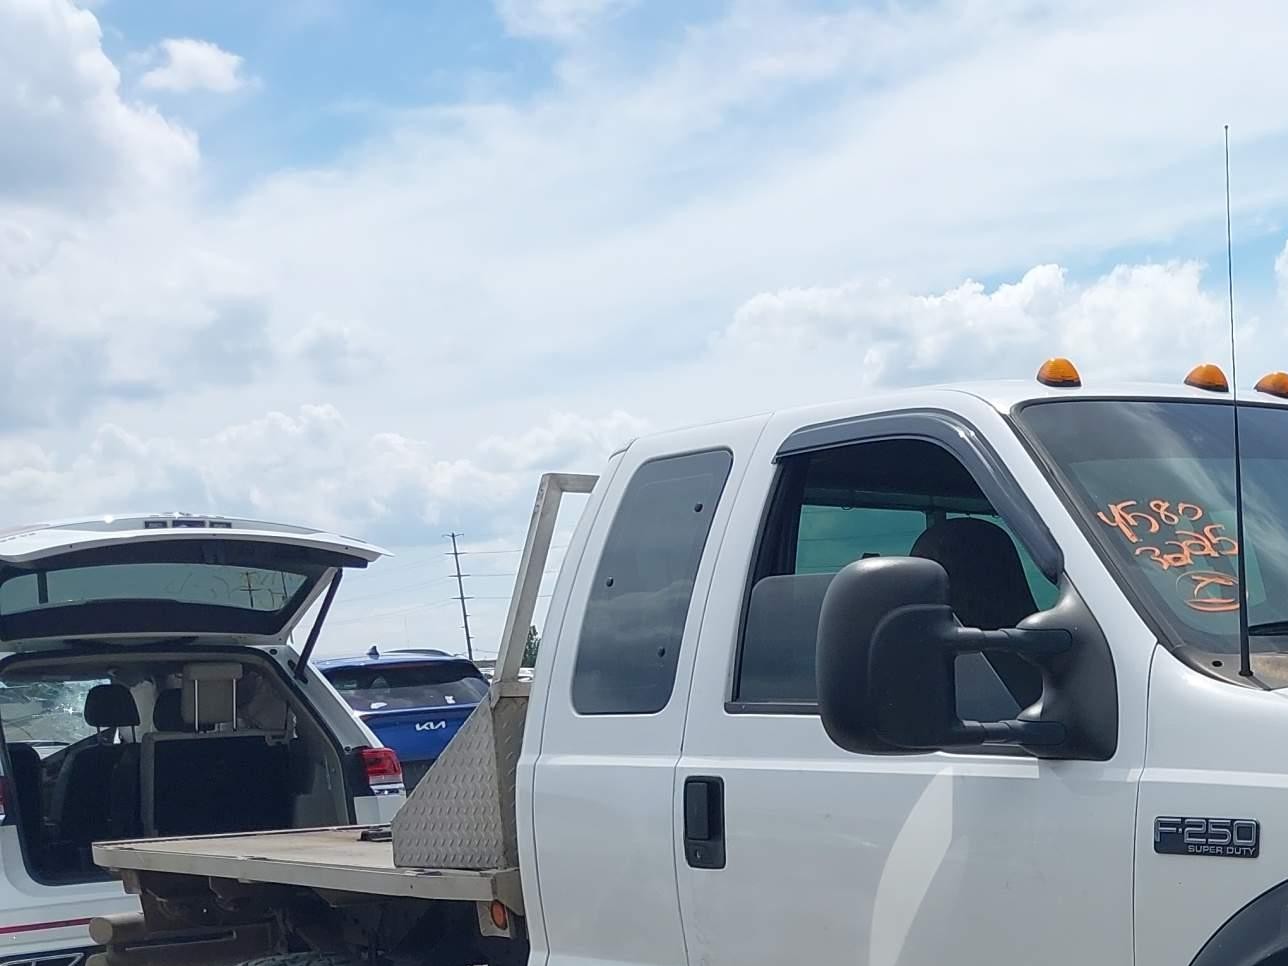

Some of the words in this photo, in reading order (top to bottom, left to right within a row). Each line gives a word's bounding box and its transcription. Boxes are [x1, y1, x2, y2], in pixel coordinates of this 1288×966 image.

[1097, 500, 1203, 543] 4580
[1188, 845, 1223, 855] SUPER
[1226, 846, 1256, 856] DUTY
